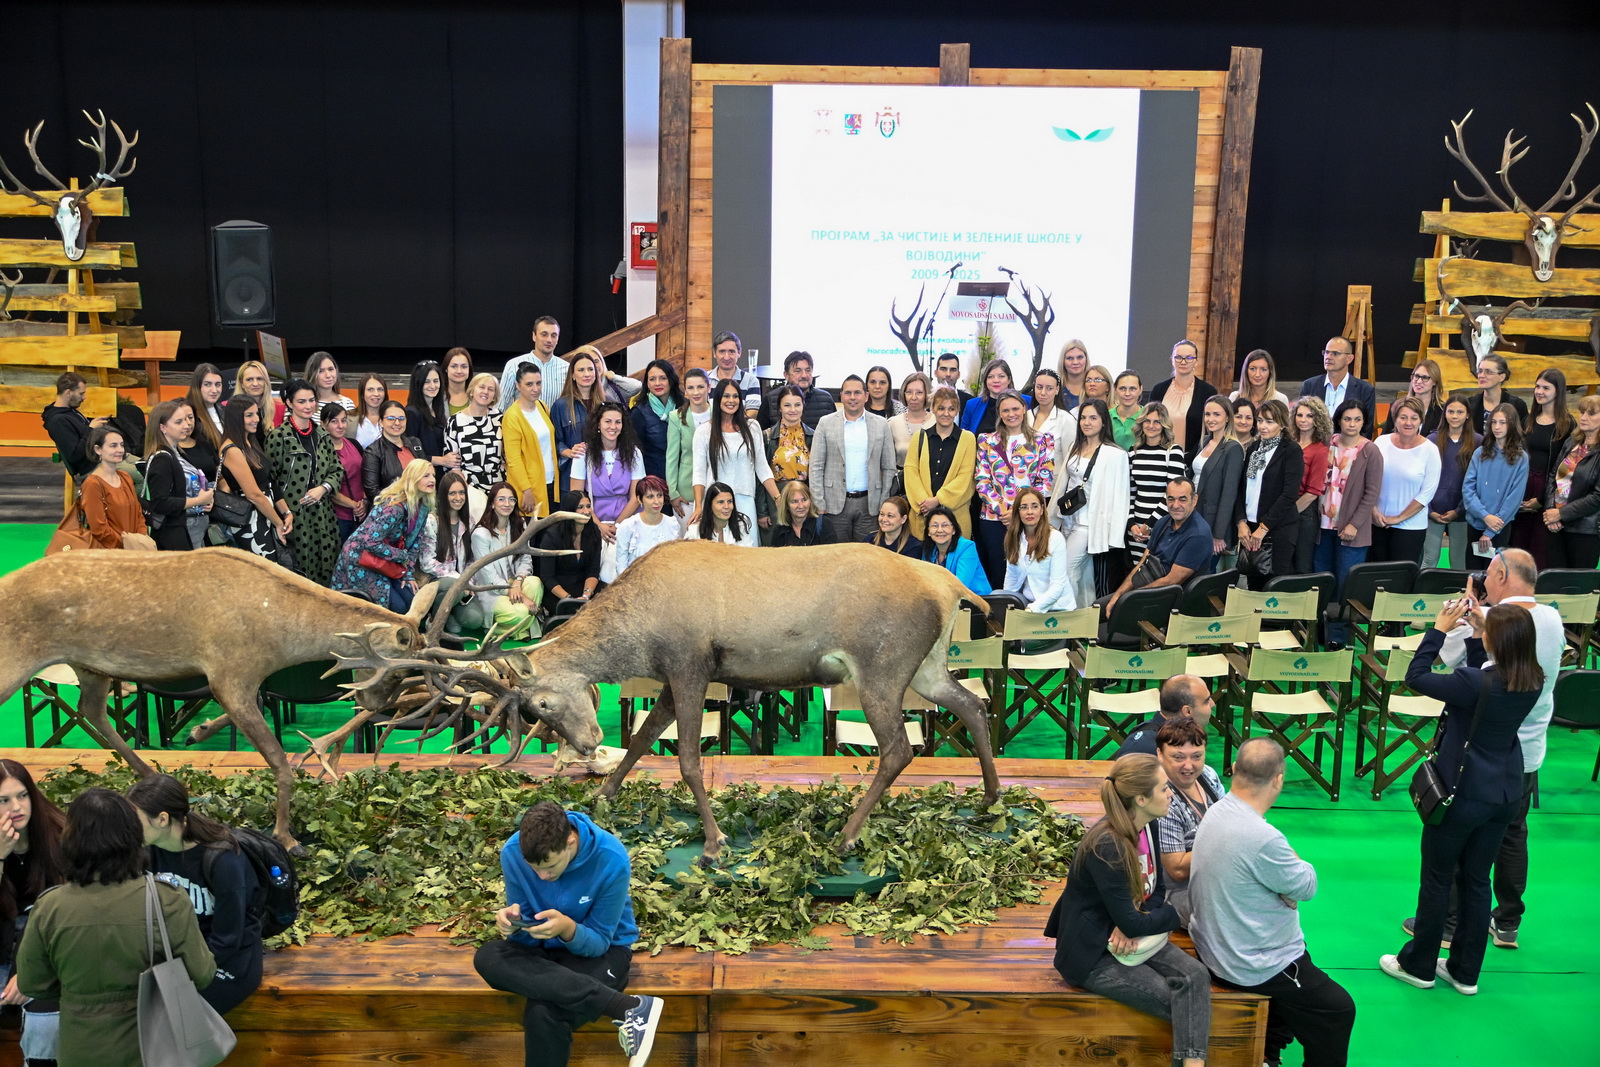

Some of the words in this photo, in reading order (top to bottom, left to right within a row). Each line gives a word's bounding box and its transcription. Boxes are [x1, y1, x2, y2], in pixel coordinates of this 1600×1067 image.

[811, 230, 870, 241] ПРОГРАМ
[898, 231, 949, 242] ЧИСТИЈЕ
[953, 232, 961, 242] И
[966, 232, 1023, 243] ЗЕЛЕНИЈЕ
[1027, 232, 1071, 243] ШКОЛЕ
[1075, 233, 1083, 244] У
[911, 269, 939, 280] 2009
[953, 269, 980, 280] 2025
[951, 311, 992, 319] NOVOSADSKI
[994, 312, 1015, 320] SAJAM
